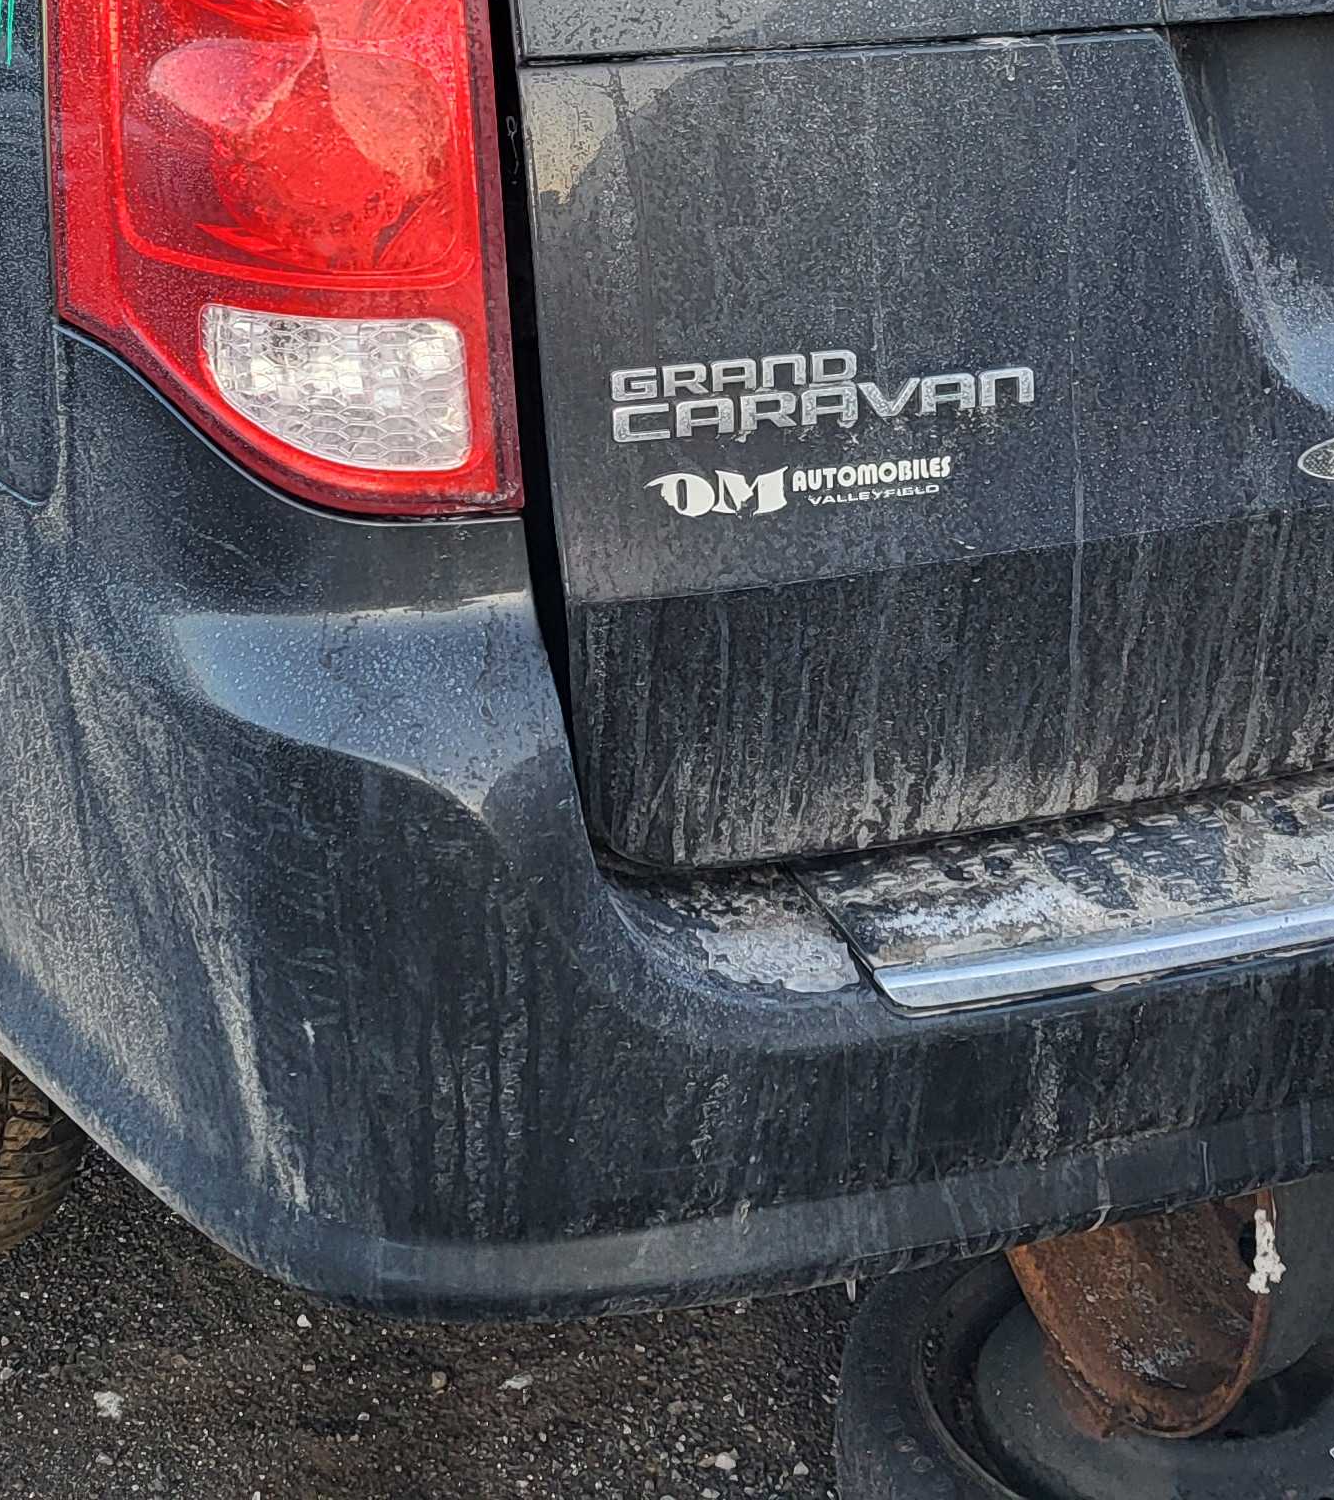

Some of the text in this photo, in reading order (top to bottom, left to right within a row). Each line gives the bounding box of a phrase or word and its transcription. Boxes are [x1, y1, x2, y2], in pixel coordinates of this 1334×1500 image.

[610, 349, 858, 402] GRAND
[611, 366, 1035, 444] CARAVAN
[792, 455, 952, 493] AUTOMOBILES
[807, 484, 940, 507] VALLEYFIELD
